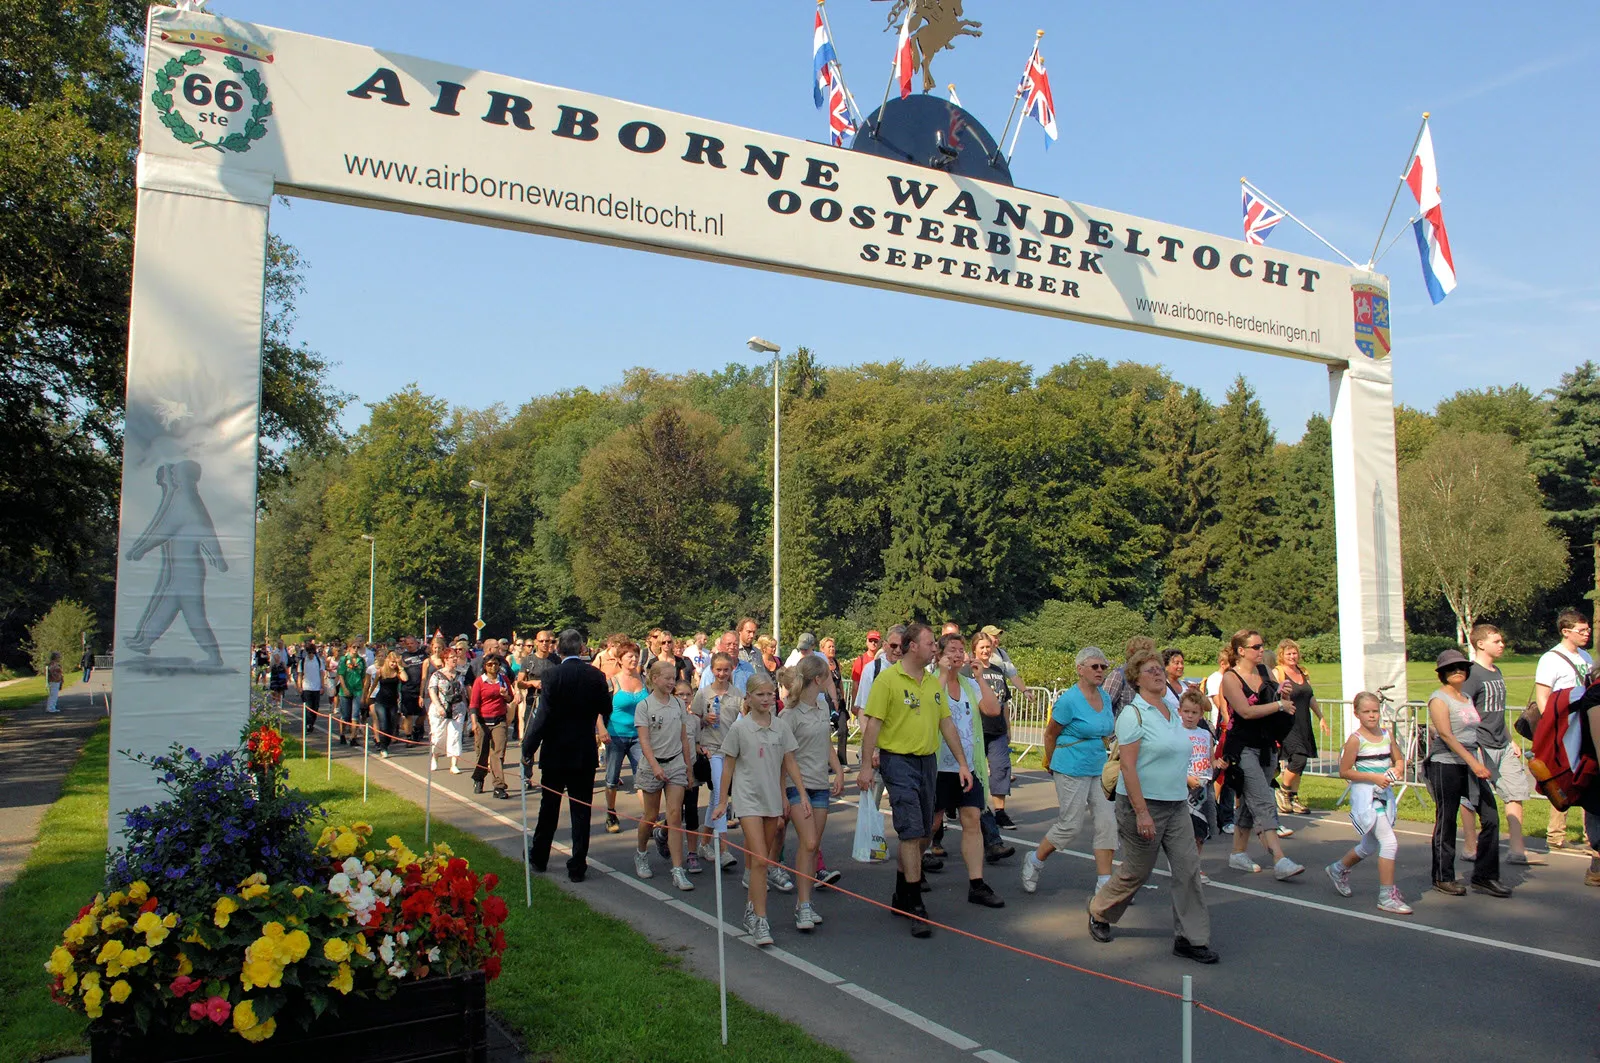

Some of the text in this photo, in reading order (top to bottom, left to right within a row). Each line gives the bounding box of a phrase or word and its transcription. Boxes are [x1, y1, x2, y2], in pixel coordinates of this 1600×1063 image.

[182, 73, 244, 112] 66
[198, 111, 229, 127] ste
[343, 153, 724, 236] www.airbornewandeltocht.nl
[347, 67, 1320, 292] AIRBORNE WANDELTOCHT
[767, 189, 1103, 275] OOSTERBEEK
[860, 244, 1080, 298] SEPTEMBER
[1135, 297, 1321, 343] www.airborne-herdenkingen.nl
